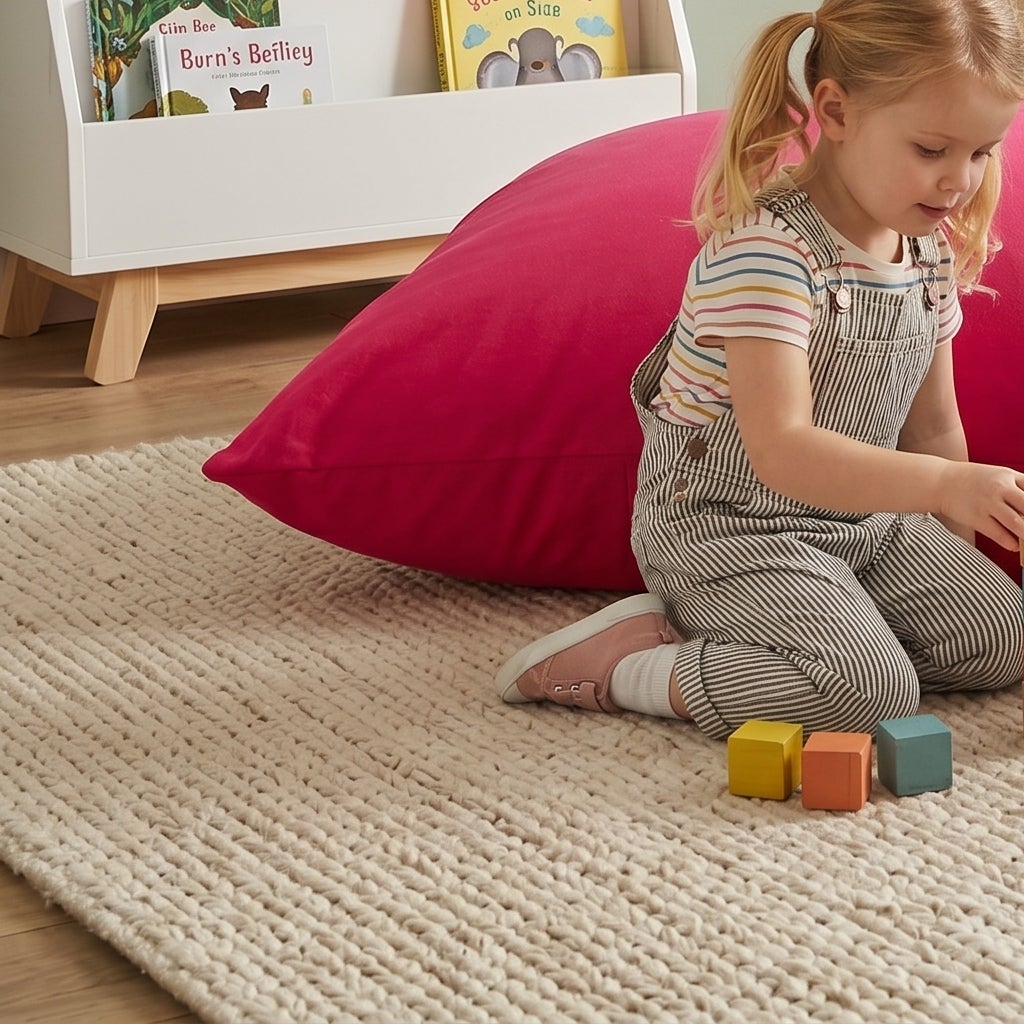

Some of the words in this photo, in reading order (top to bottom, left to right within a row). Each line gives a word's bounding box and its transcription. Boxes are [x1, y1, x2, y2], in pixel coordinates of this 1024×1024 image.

[504, 7, 521, 21] on
[193, 19, 216, 33] Bee
[180, 47, 241, 70] Burn's
